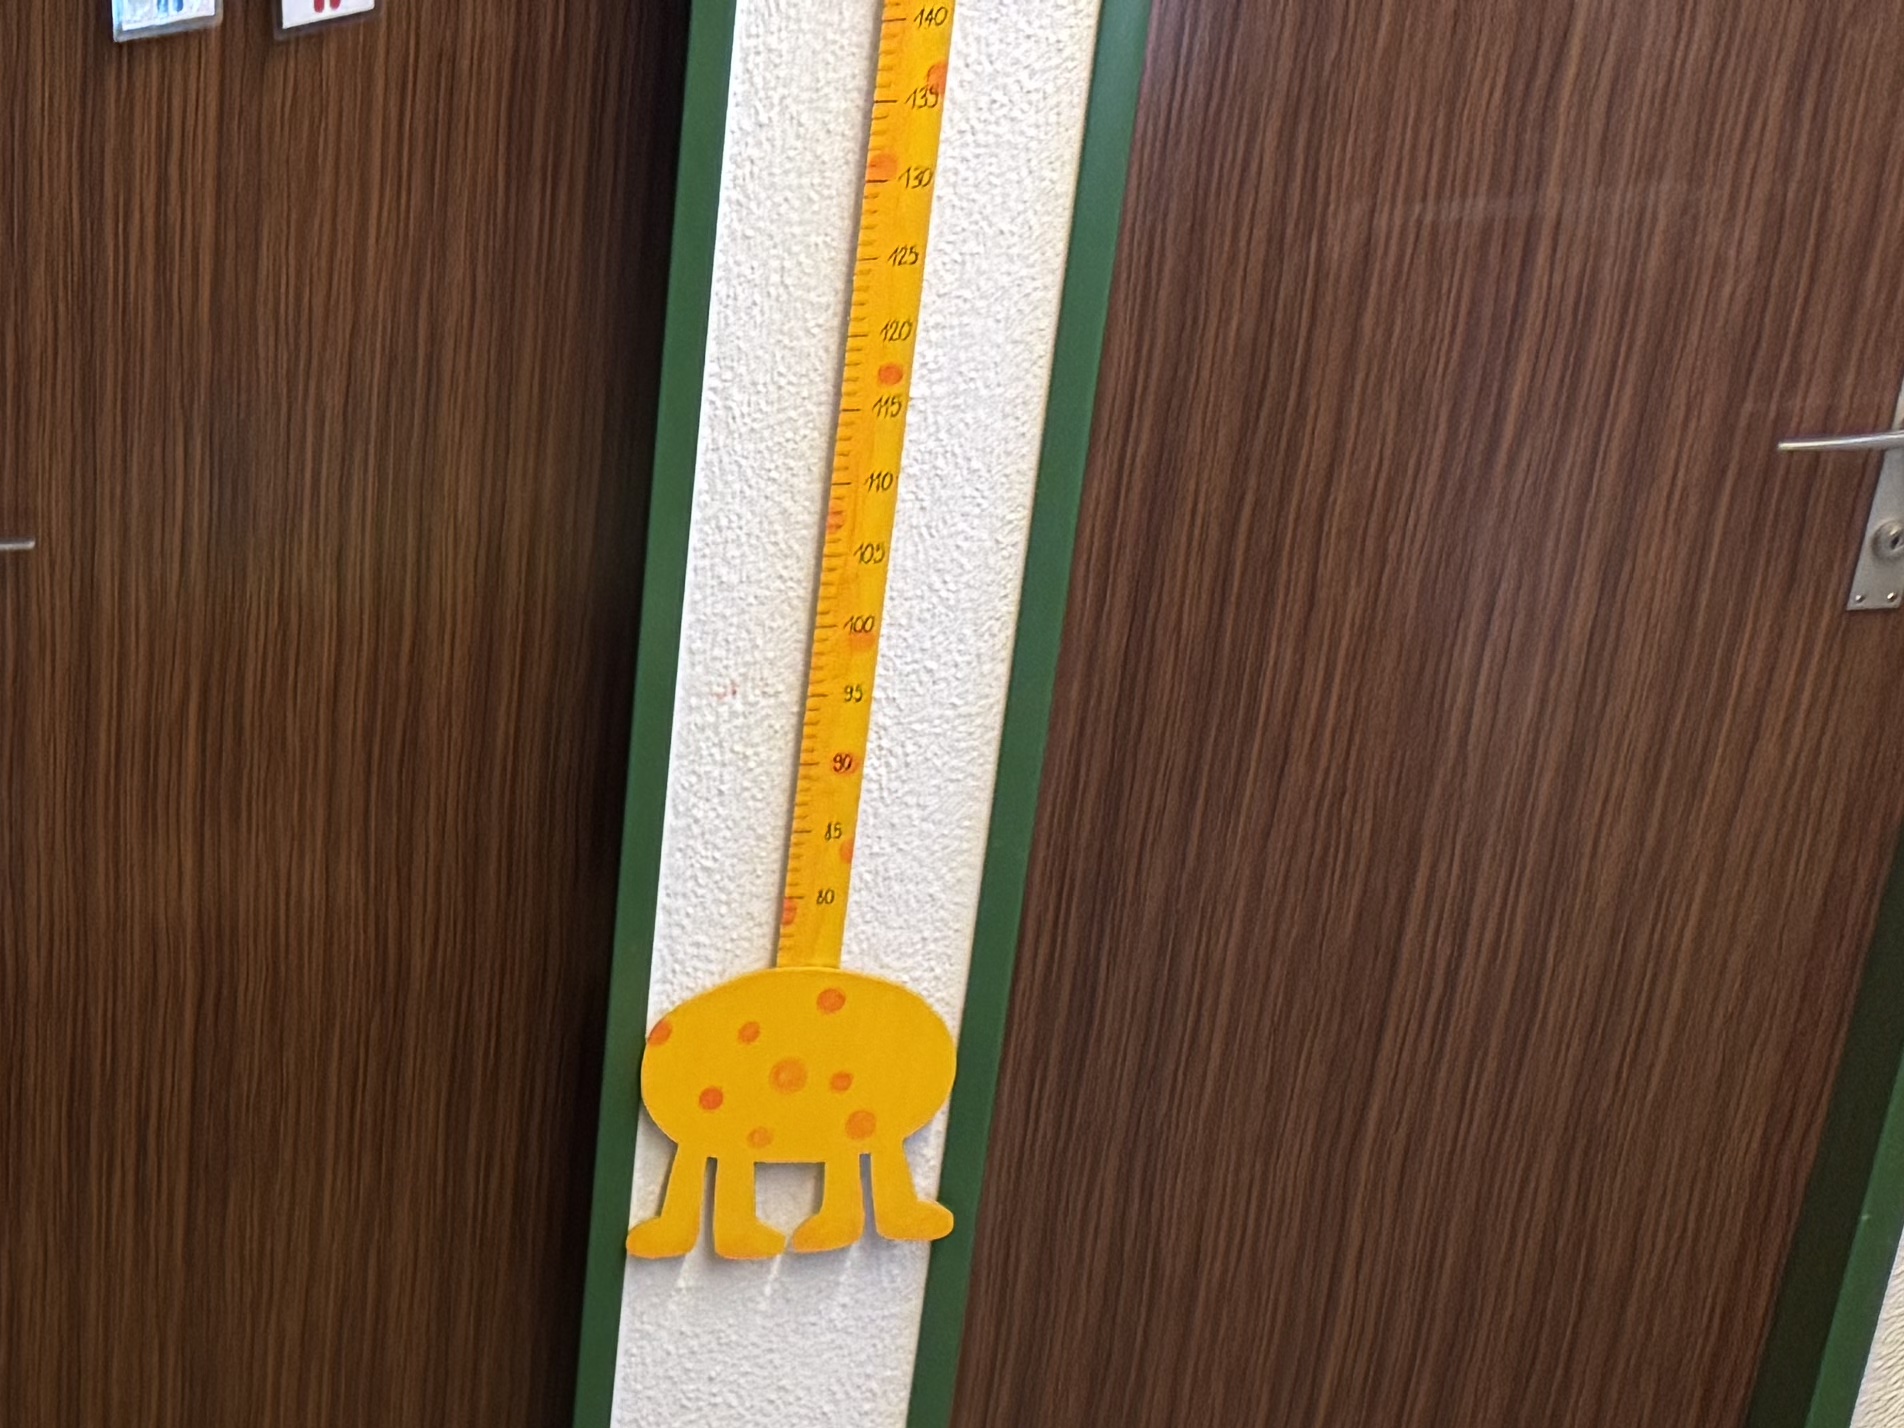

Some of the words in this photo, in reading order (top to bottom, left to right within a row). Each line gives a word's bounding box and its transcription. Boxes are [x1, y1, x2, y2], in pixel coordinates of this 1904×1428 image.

[914, 6, 948, 28] 140
[904, 83, 939, 109] 135
[898, 167, 933, 189] 130
[887, 245, 919, 267] 125
[879, 319, 913, 342] 120
[872, 396, 902, 419] 115
[864, 472, 893, 493] 110
[853, 542, 886, 564] 105
[844, 615, 875, 635] 100
[843, 685, 863, 702] 95
[832, 753, 852, 772] 90
